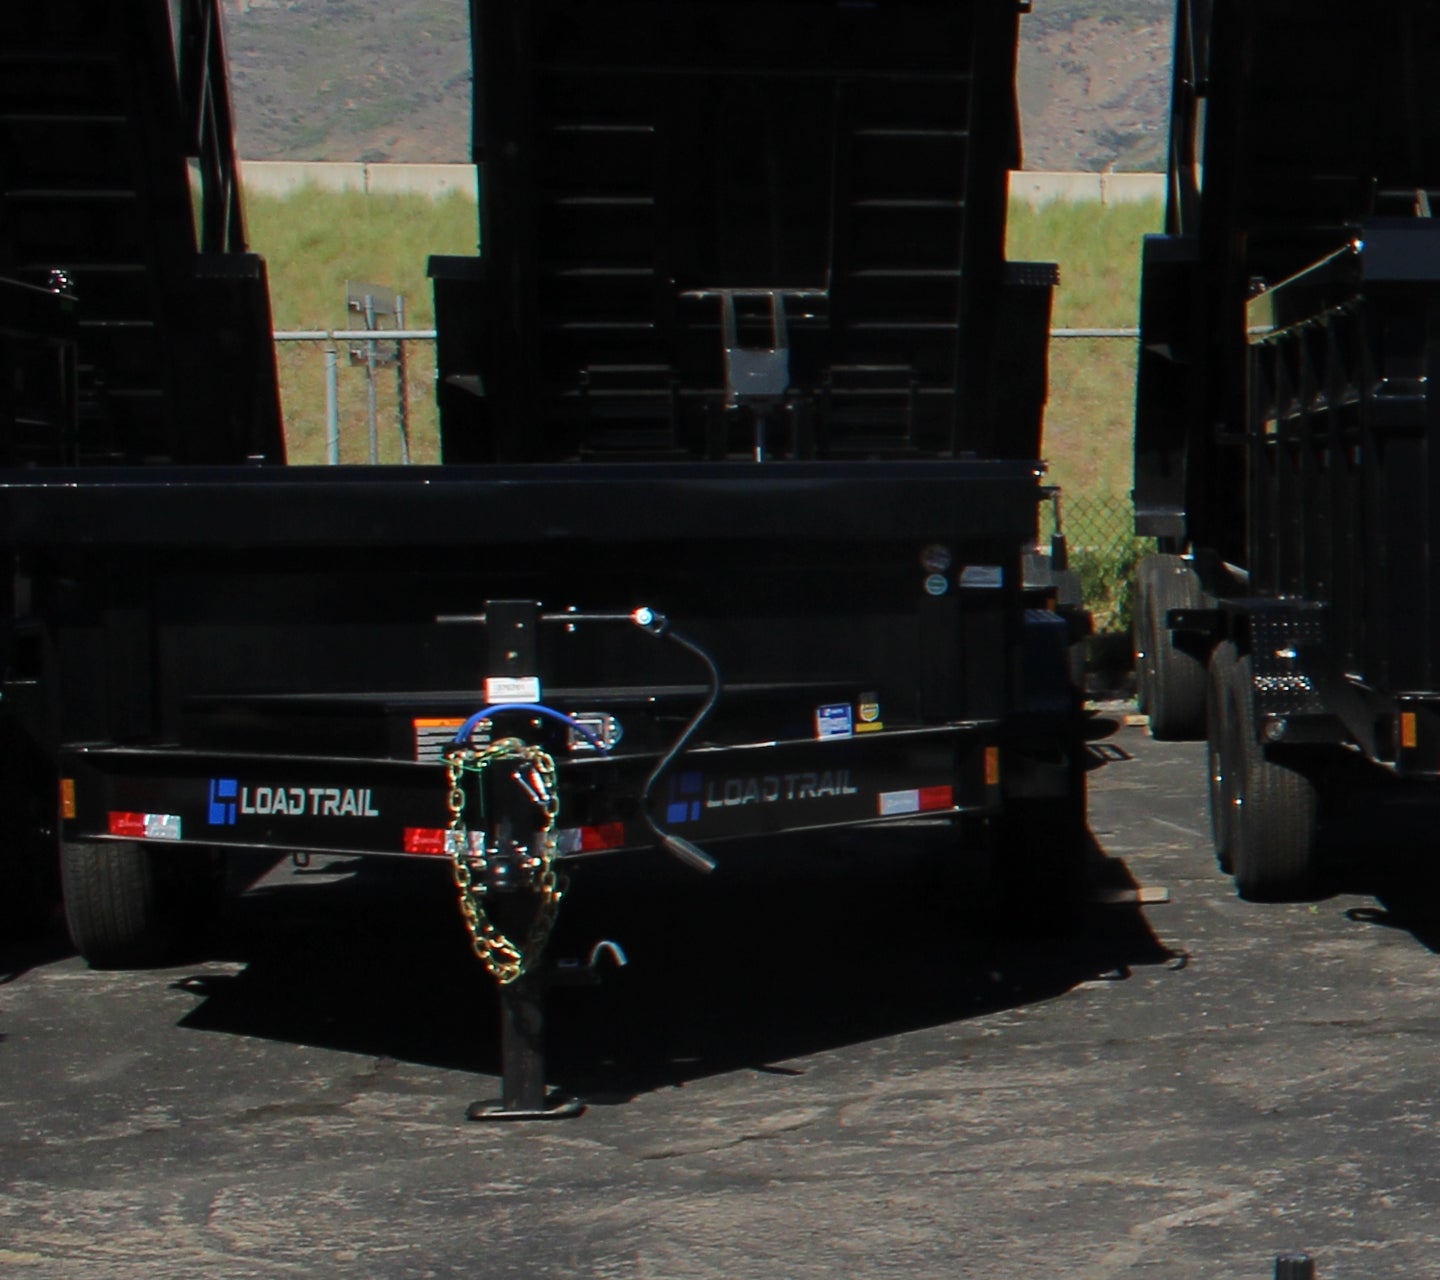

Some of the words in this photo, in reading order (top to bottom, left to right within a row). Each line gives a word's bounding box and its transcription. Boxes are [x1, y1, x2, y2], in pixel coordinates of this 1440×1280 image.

[240, 786, 305, 816] LOAD
[307, 787, 380, 817] TRAIL
[706, 776, 779, 808] LOAD
[779, 769, 858, 799] TRAIL
